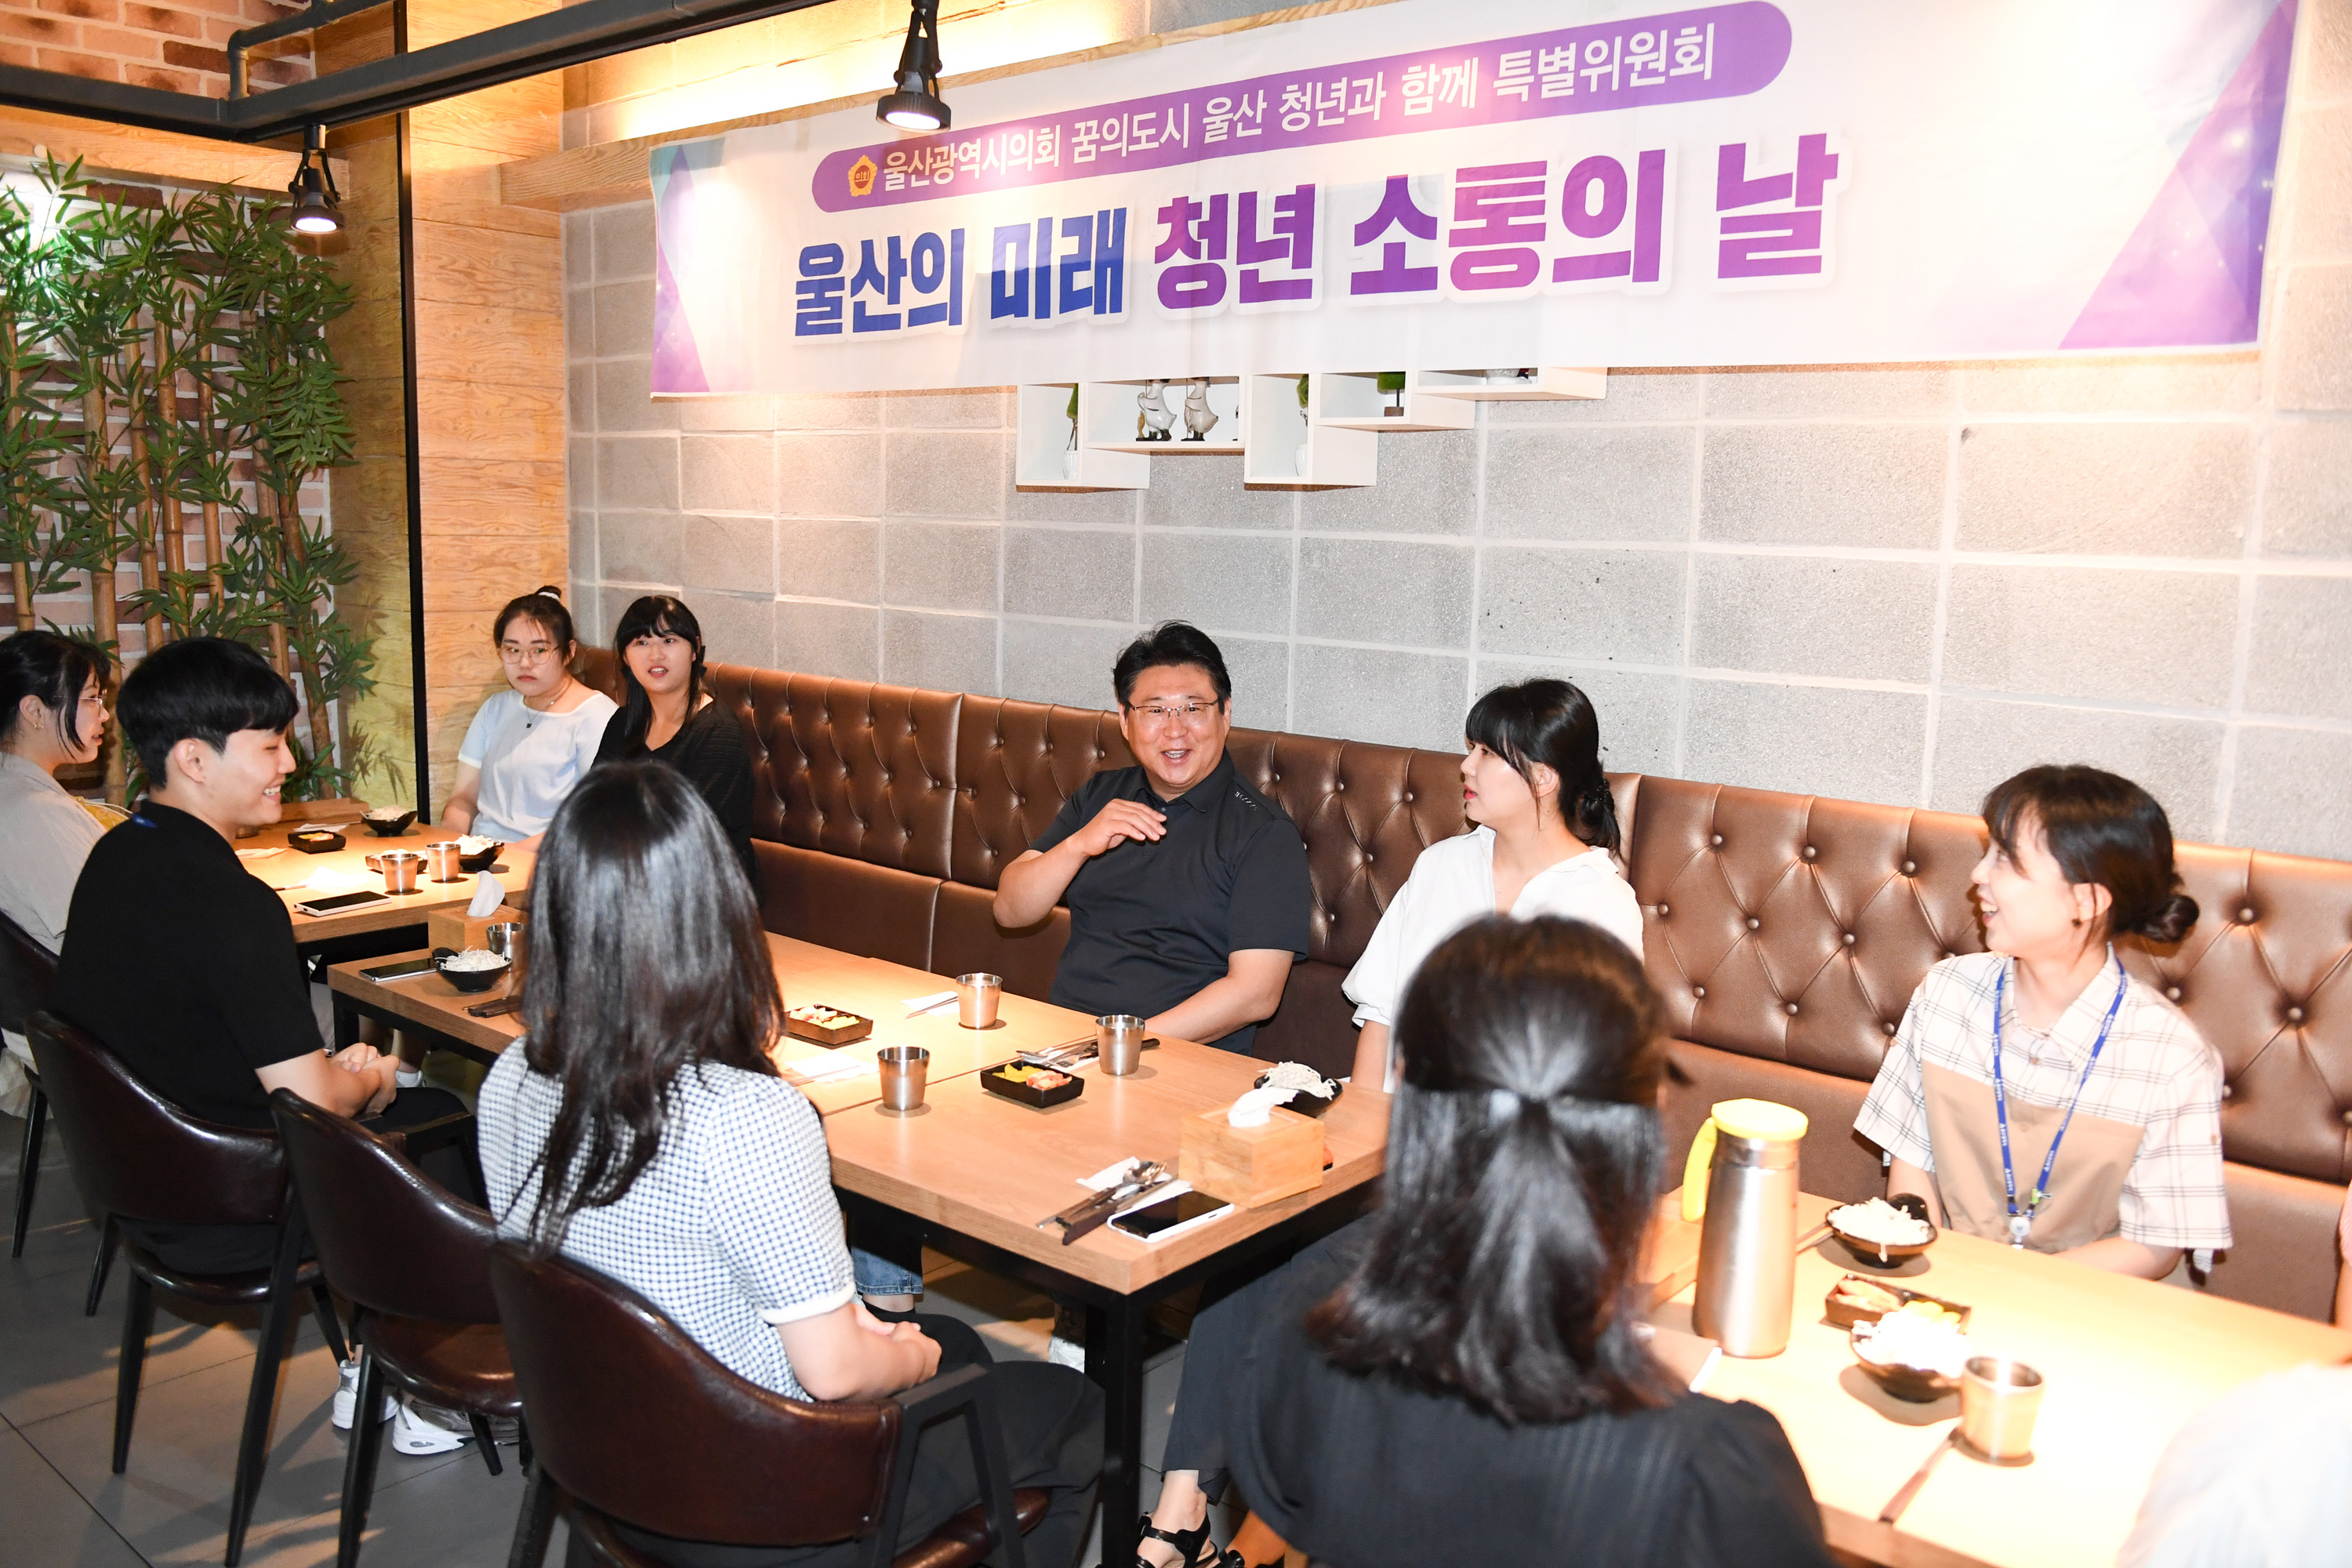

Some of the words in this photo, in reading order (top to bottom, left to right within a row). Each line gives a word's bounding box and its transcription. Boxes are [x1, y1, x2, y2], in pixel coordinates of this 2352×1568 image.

[855, 170, 870, 182] 의회
[884, 125, 1059, 191] 울산광역시의회
[1071, 104, 1190, 165] 꿈의도시
[1203, 89, 1267, 143] 울산
[1279, 71, 1386, 132] 청년과
[1400, 57, 1478, 117] 함께
[1494, 22, 1715, 103] 특별위원회
[794, 228, 965, 337] 울산의
[990, 207, 1127, 321] 미래
[1155, 183, 1316, 310] 청년
[1350, 149, 1666, 296] 소통의
[1715, 132, 1839, 280] 날
